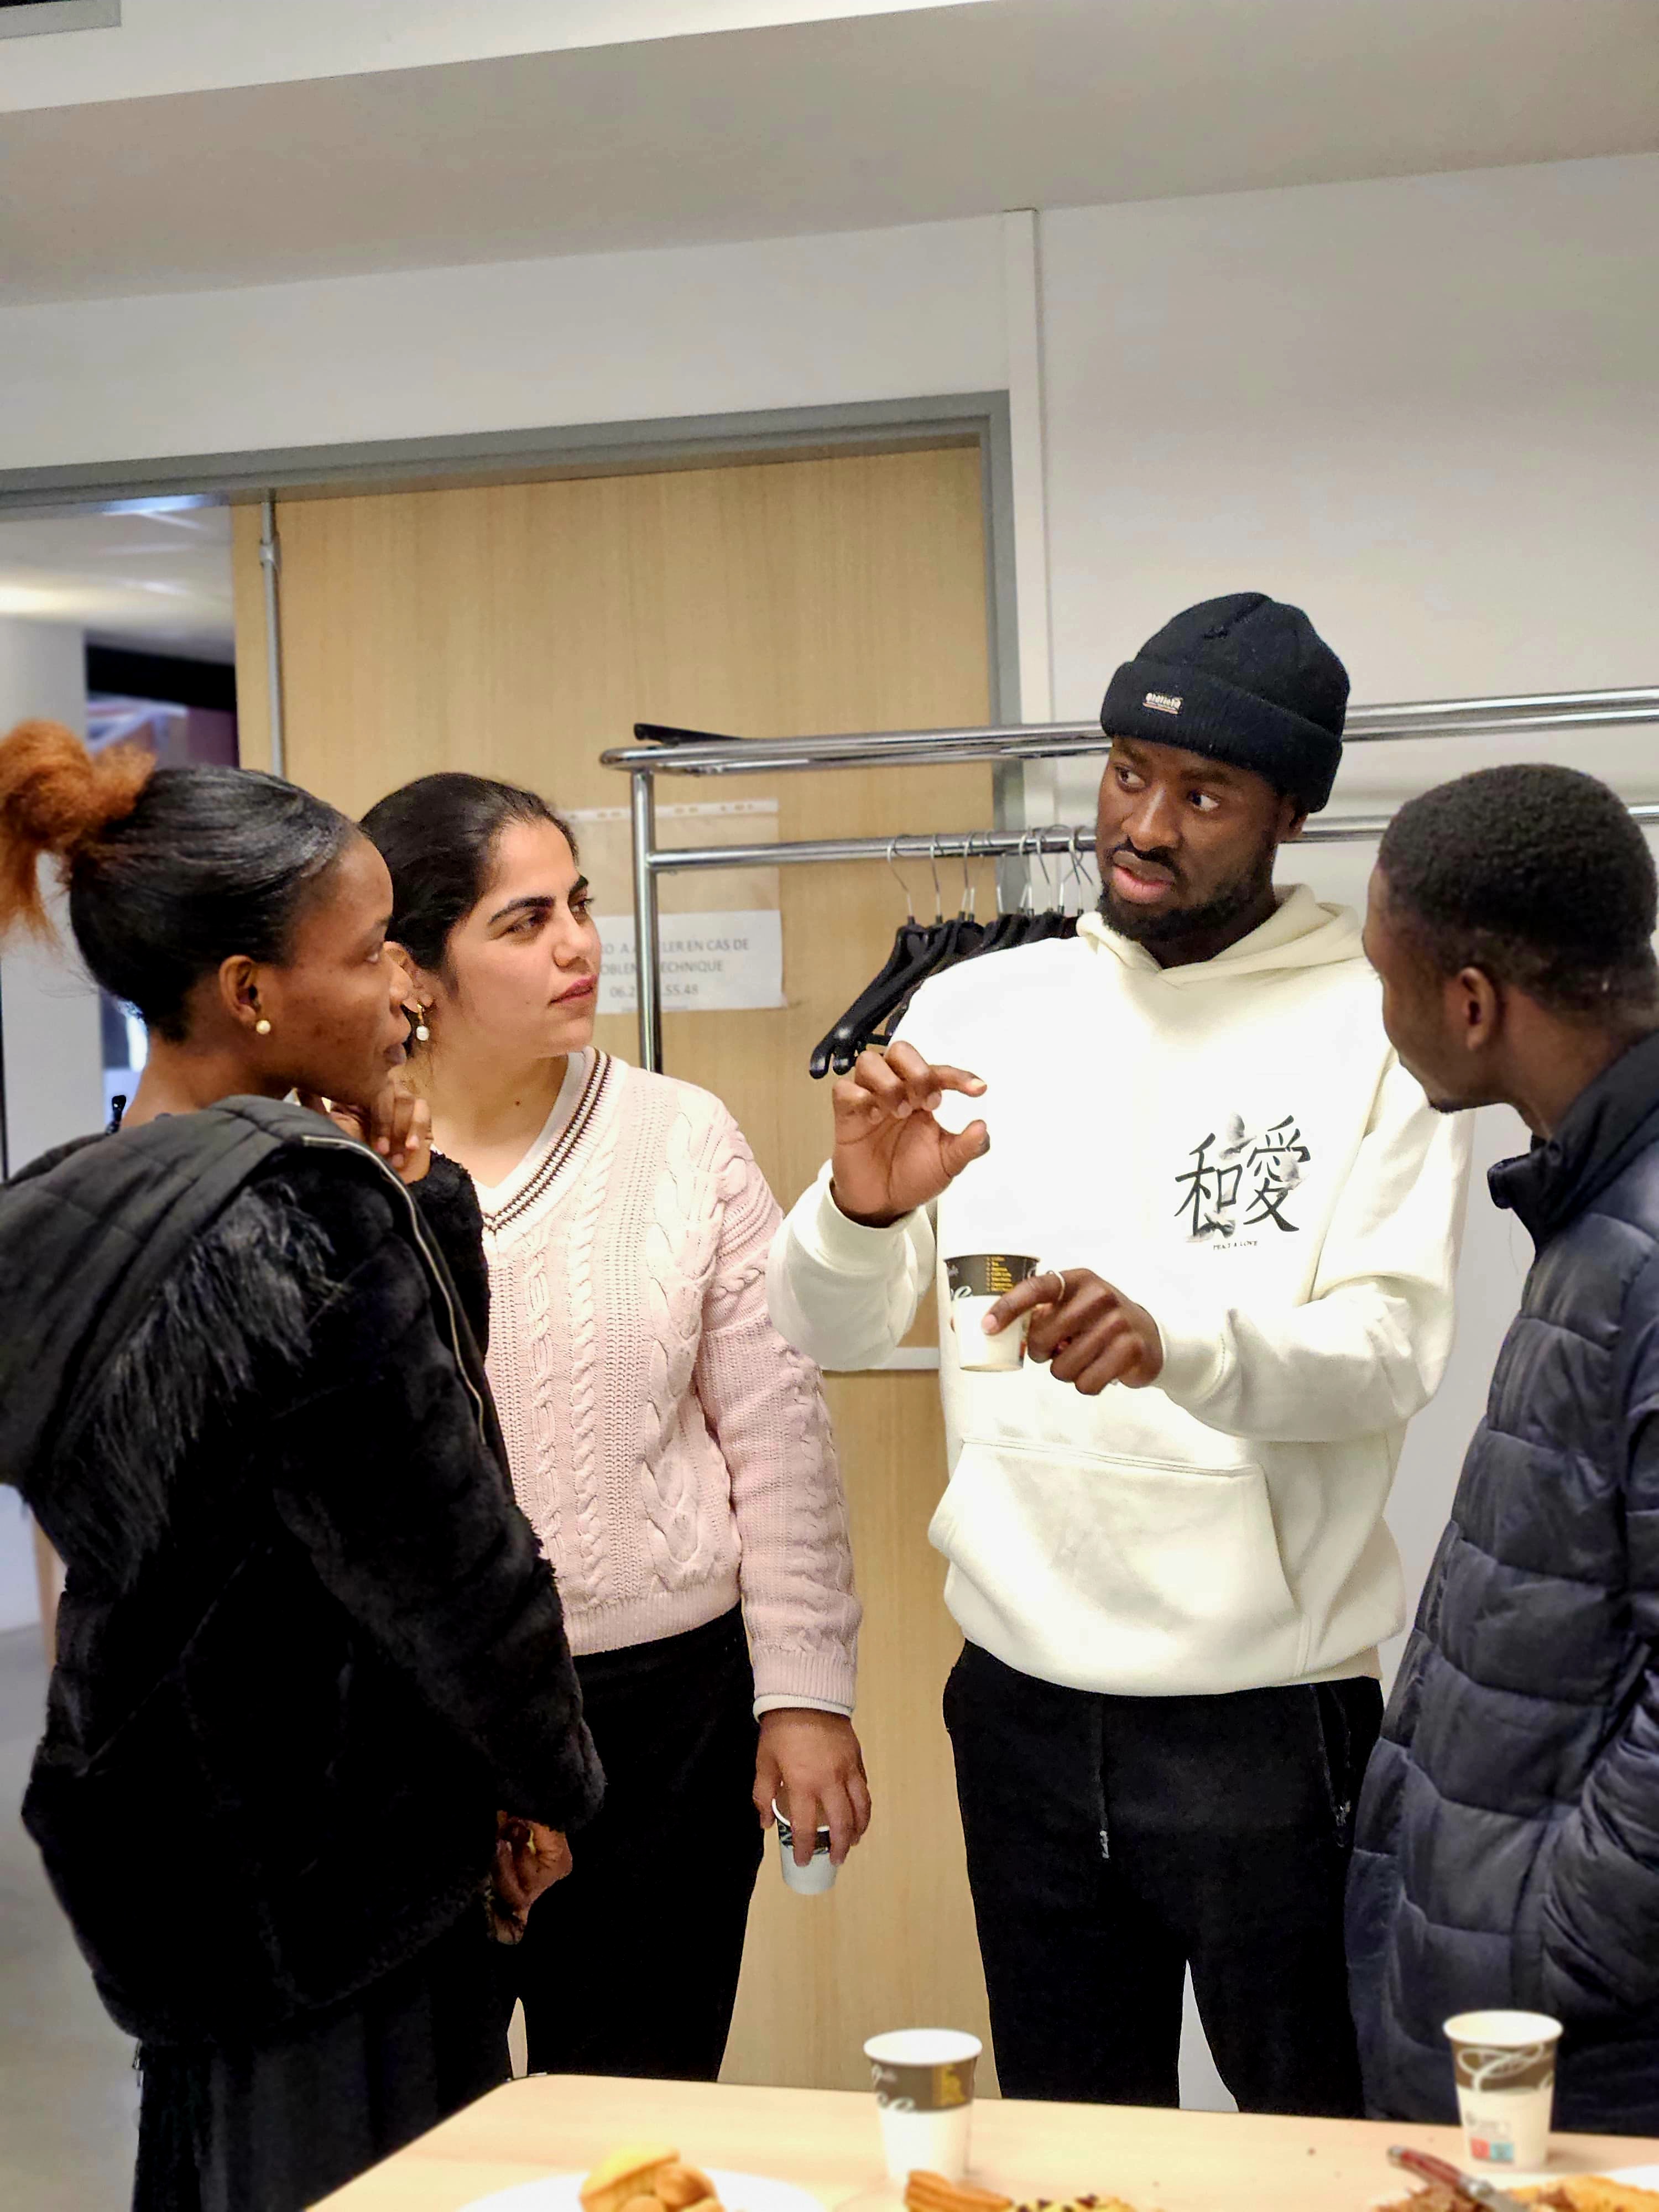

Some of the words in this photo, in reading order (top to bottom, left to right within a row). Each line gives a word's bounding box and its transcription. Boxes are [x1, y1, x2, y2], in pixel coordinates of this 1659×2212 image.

[687, 939, 704, 952] EN
[706, 938, 730, 951] CAS
[733, 938, 749, 951] DE
[660, 959, 724, 973] ECHNIQUE
[1174, 1115, 1311, 1237] 和愛
